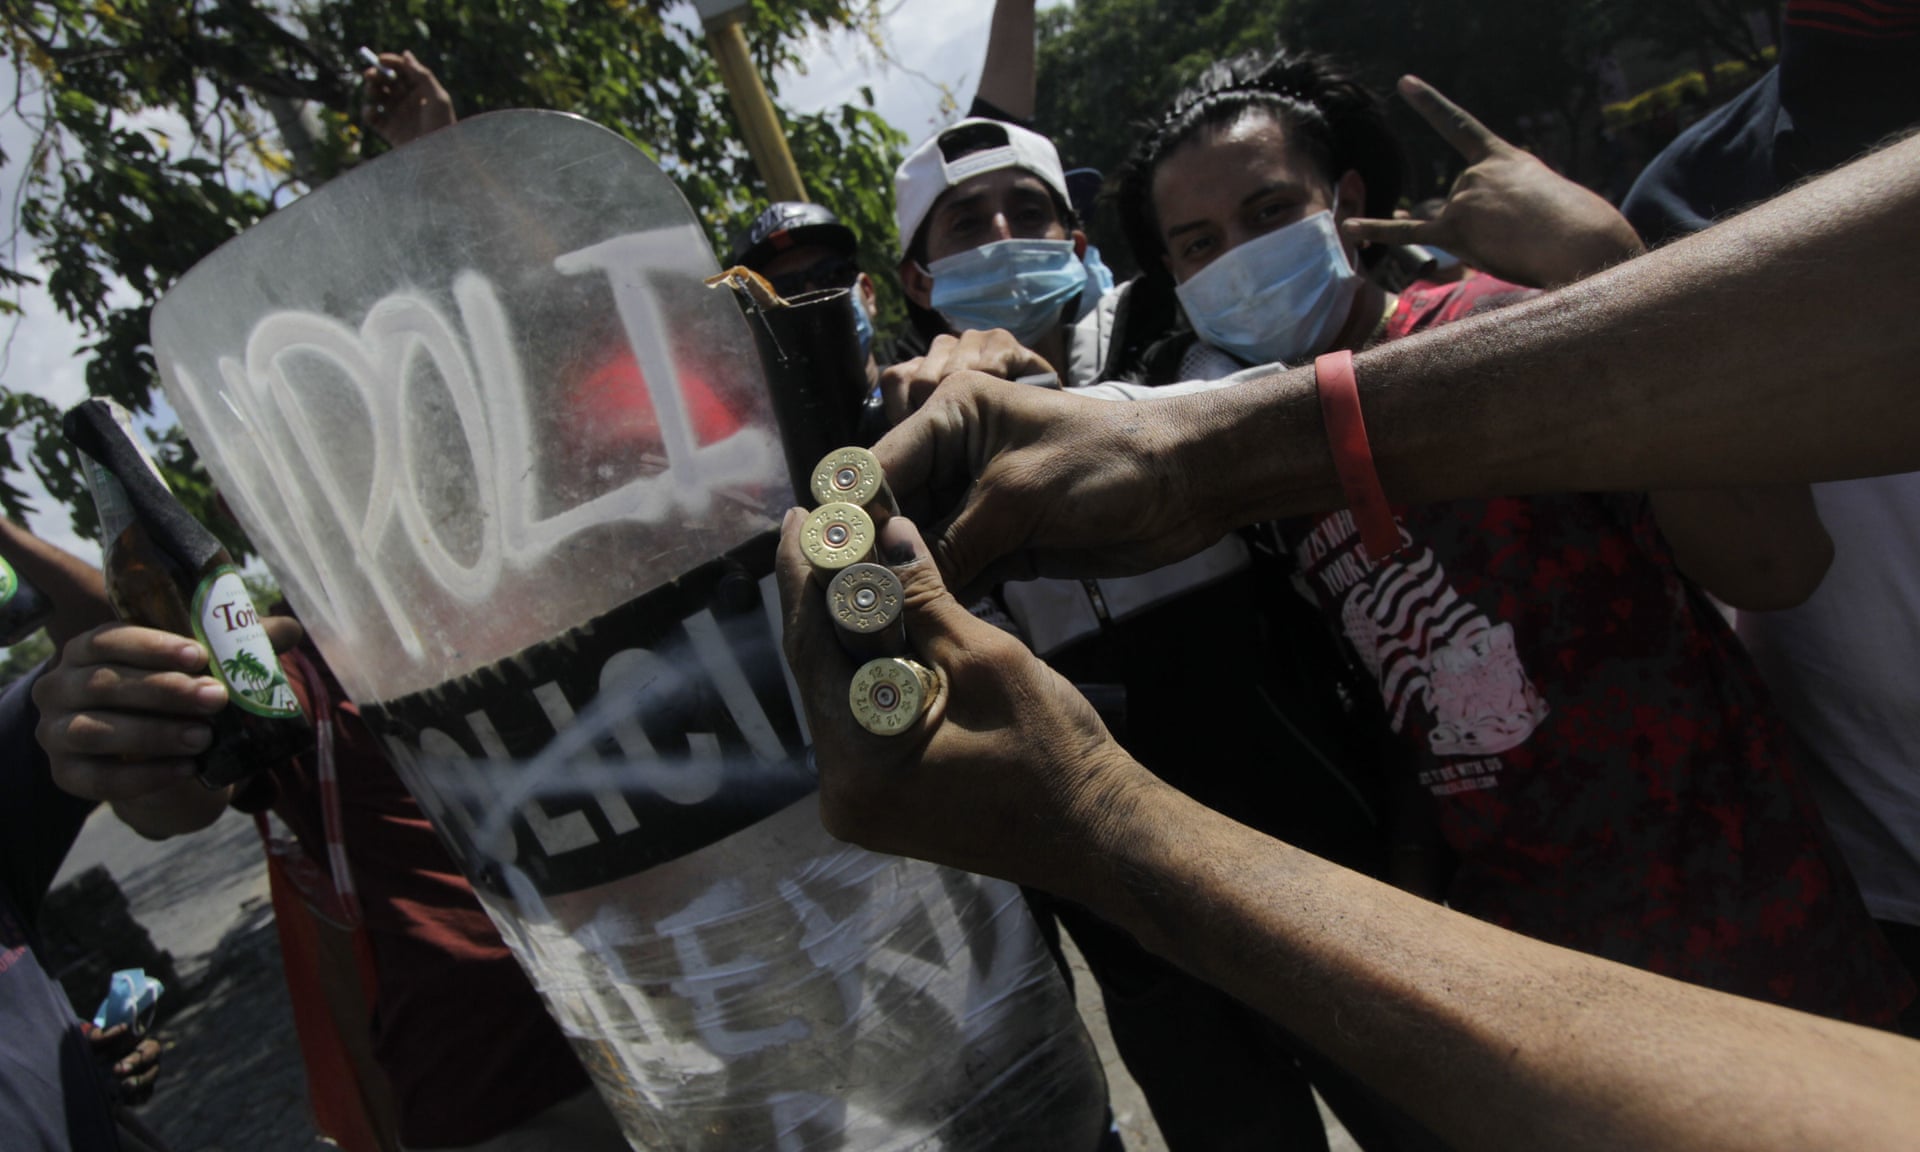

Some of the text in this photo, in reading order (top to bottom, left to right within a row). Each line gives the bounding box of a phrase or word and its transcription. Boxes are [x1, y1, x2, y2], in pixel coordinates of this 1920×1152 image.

[841, 573, 857, 588] 12
[1318, 551, 1366, 597] YOUR
[878, 575, 893, 591] 12
[838, 607, 853, 622] 12
[875, 610, 890, 624] 12
[382, 571, 813, 864] POLICI
